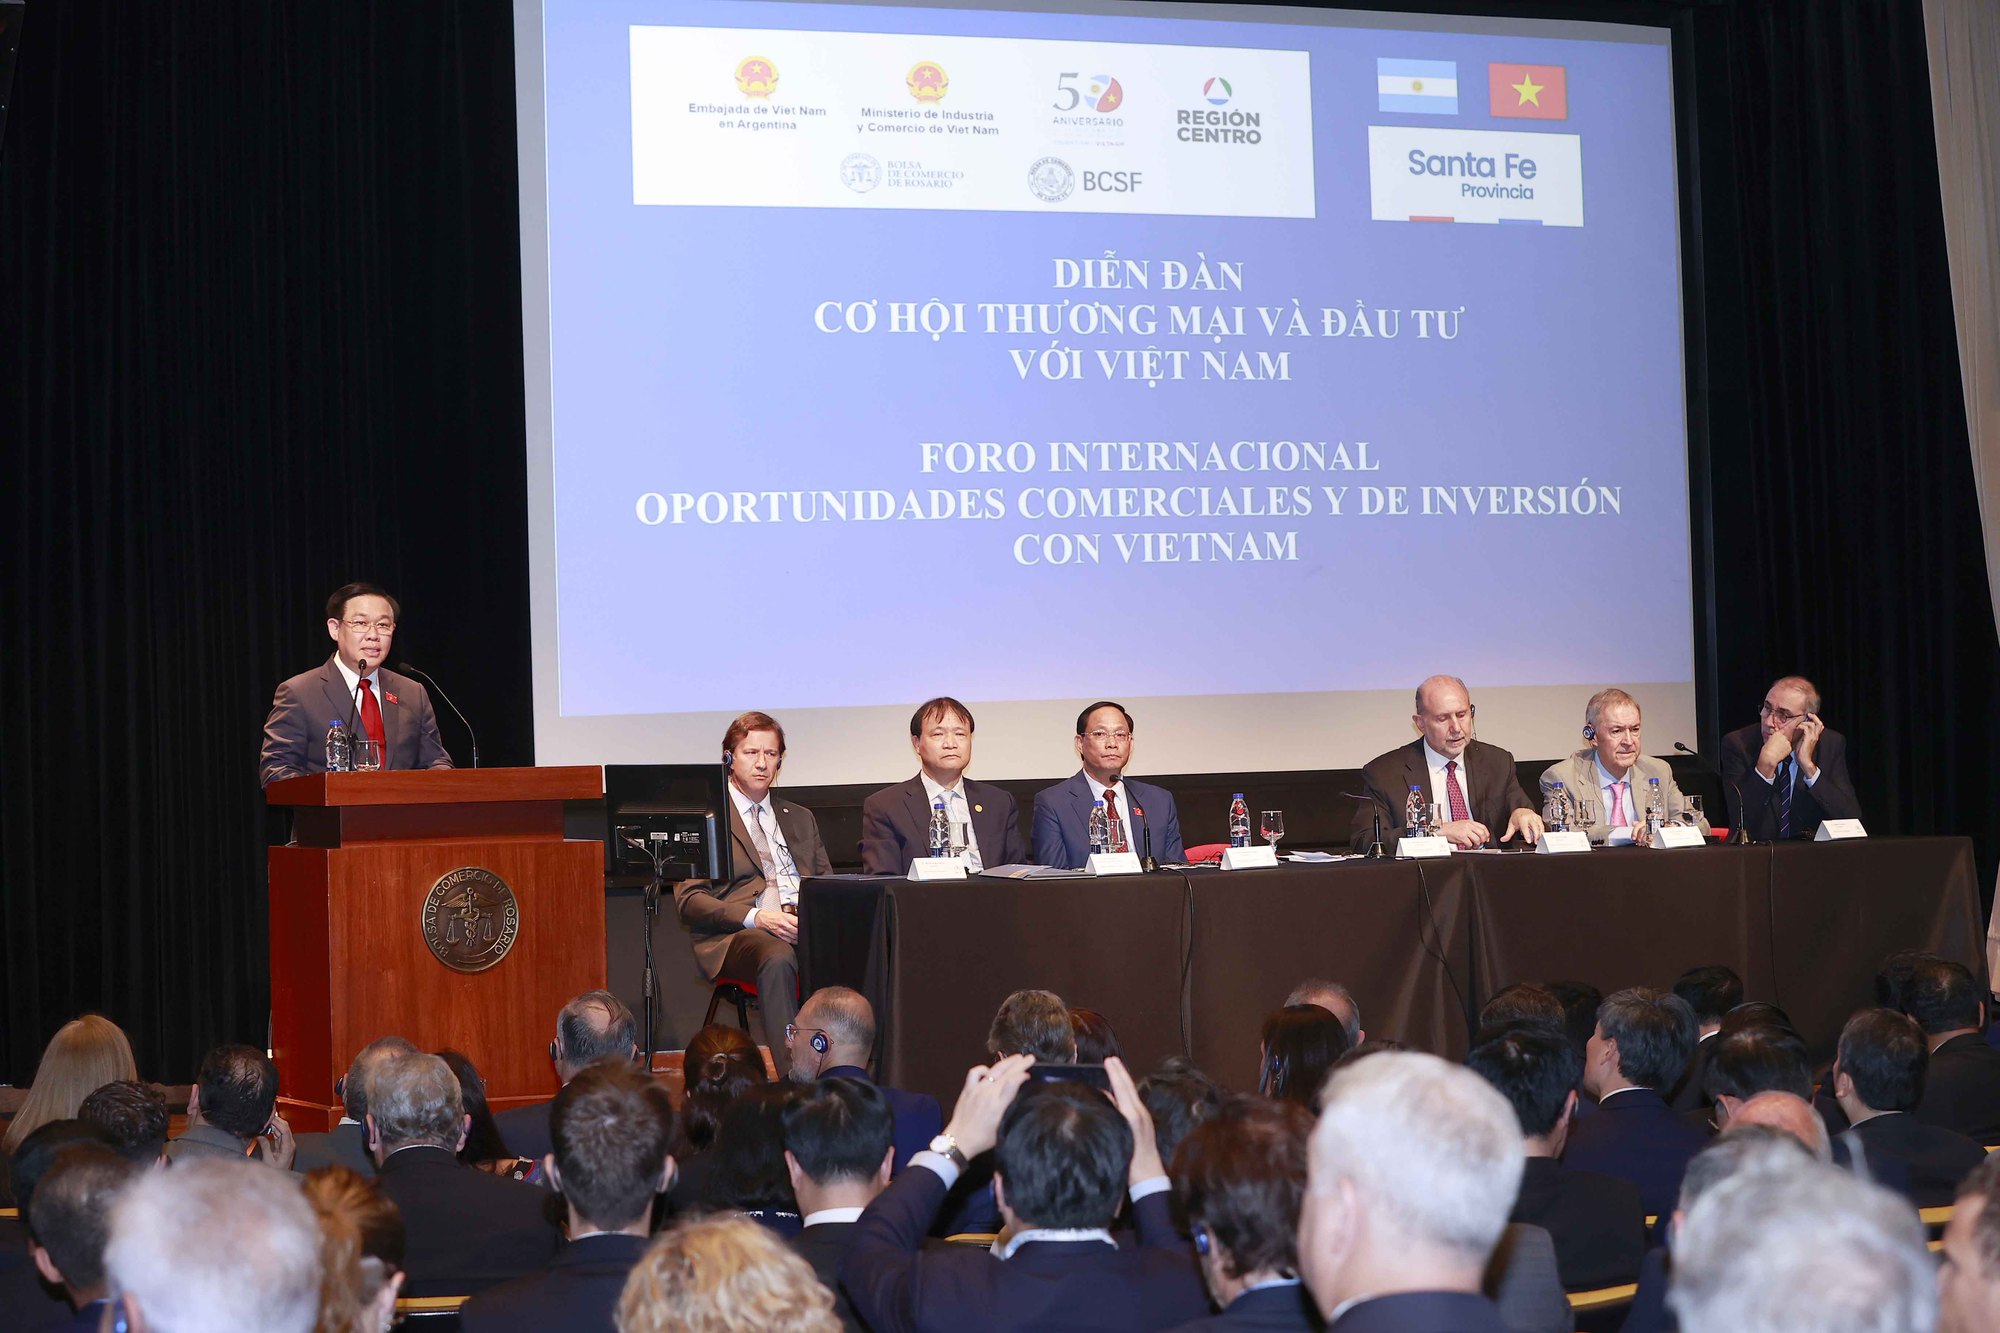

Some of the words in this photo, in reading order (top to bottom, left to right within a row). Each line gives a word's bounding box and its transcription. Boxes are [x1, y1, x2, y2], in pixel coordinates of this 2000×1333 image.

[688, 103, 750, 116] Embajada
[753, 104, 768, 115] de
[772, 104, 796, 115] Viet
[799, 105, 827, 116] Nam
[861, 107, 920, 120] Ministerio
[924, 109, 938, 120] de
[942, 109, 995, 121] Industria
[1176, 108, 1261, 127] REGIÓN
[719, 120, 734, 129] en
[737, 119, 797, 132] Argentina
[857, 125, 864, 134] y
[867, 122, 926, 134] Comercio
[929, 123, 943, 134] de
[947, 124, 970, 135] Viet
[973, 125, 1000, 136] Nam
[1053, 116, 1124, 127] ANIVERSARIO
[1176, 127, 1262, 145] CENTRO
[887, 160, 922, 169] BOLSA
[1408, 149, 1496, 178] Santa
[1505, 153, 1537, 180] Fe
[888, 169, 903, 178] DE
[904, 169, 965, 179] COMERCIO
[1083, 170, 1143, 193] BCSF
[888, 178, 903, 187] DE
[904, 178, 953, 189] ROSARIO
[1461, 182, 1534, 200] Provincia
[1052, 249, 1150, 290] DIỄN
[1160, 251, 1244, 292] ĐÀN
[813, 298, 877, 334] CƠ
[887, 297, 968, 342] HỘI
[977, 298, 1158, 336] THƯƠNG
[1168, 304, 1247, 344] MẠI
[1256, 298, 1312, 337] VÀ
[1320, 298, 1401, 339] ĐẦU
[1410, 305, 1466, 340] TƯ
[1008, 340, 1085, 380] VỚI
[1095, 345, 1191, 388] VIỆT
[1199, 350, 1292, 382] NAM
[918, 441, 1037, 474] FORO
[1047, 440, 1380, 473] INTERNACIONAL
[635, 488, 1006, 526] OPORTUNIDADES
[1017, 486, 1313, 519] COMERCIALES
[1321, 486, 1348, 516] Y
[1358, 486, 1410, 516] DE
[1419, 477, 1622, 517] INVERSIÓN
[1013, 532, 1102, 566] CON
[1112, 531, 1300, 564] VIETNAM
[426, 896, 440, 913] DE
[494, 897, 516, 956] ROSARIO
